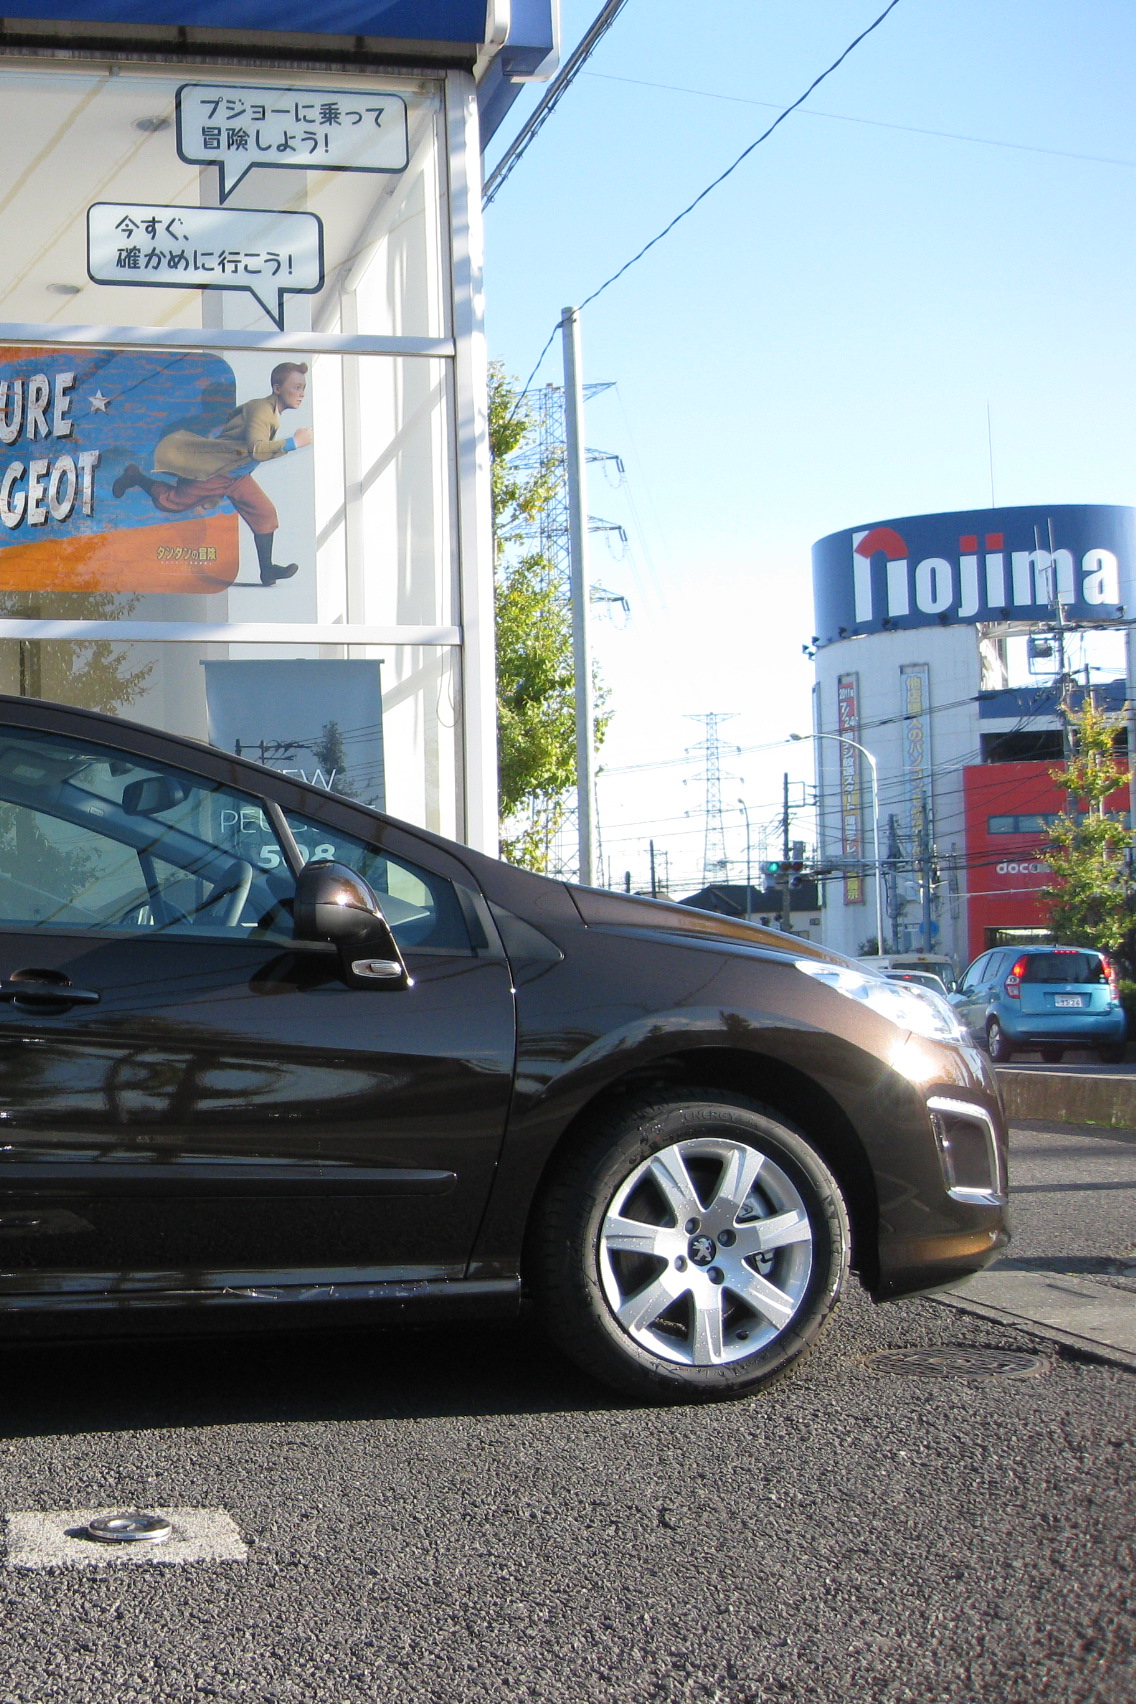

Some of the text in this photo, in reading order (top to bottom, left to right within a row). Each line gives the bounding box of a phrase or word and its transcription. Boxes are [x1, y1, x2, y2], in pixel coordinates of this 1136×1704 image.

[200, 97, 385, 128] プジョーに乗って
[202, 126, 330, 155] 冒険しよう!
[115, 215, 190, 242] 今すぐ、
[115, 246, 294, 276] 確かめに行こう!
[157, 546, 217, 560] タンタンの冒険
[852, 527, 1121, 623] nojima
